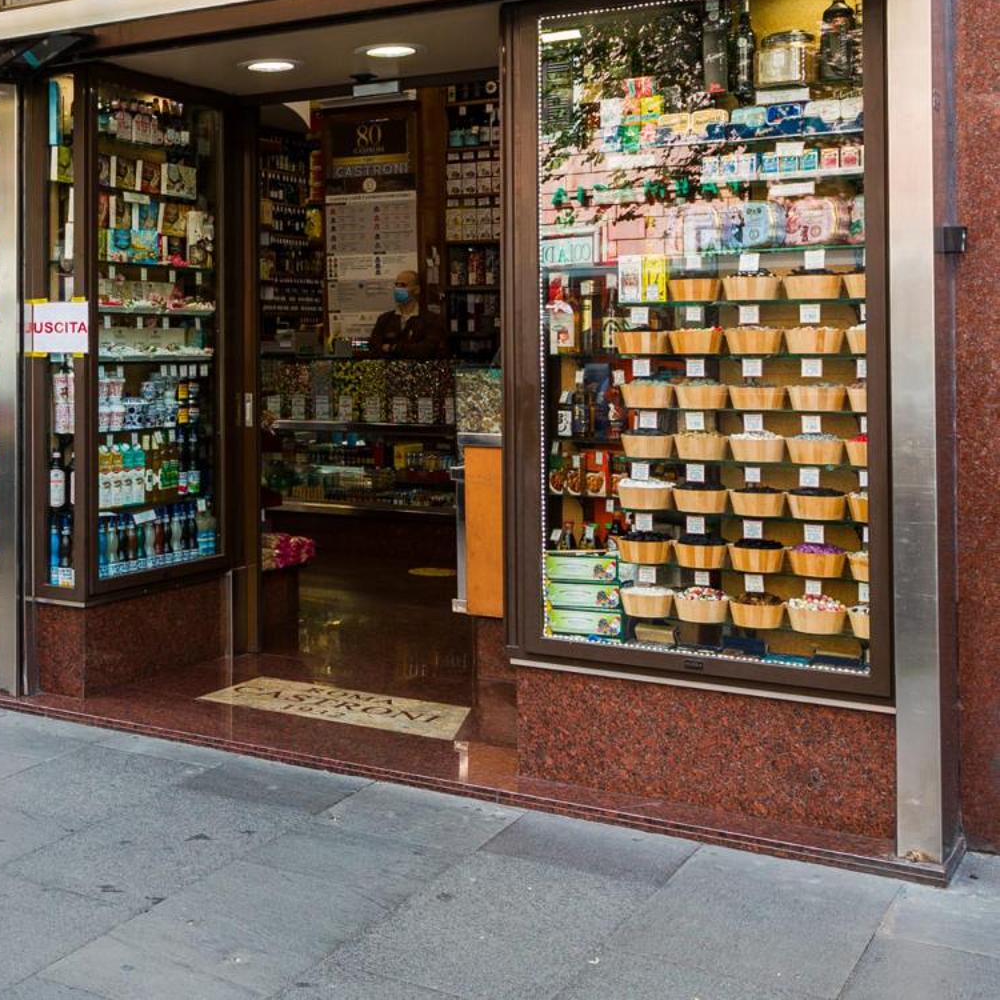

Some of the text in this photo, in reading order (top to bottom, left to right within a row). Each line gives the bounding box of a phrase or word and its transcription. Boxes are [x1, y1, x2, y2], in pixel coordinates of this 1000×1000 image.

[356, 123, 382, 148] 80
[34, 321, 88, 334] USCITA
[233, 684, 442, 723] CASTRONI
[310, 686, 393, 706] ROMA
